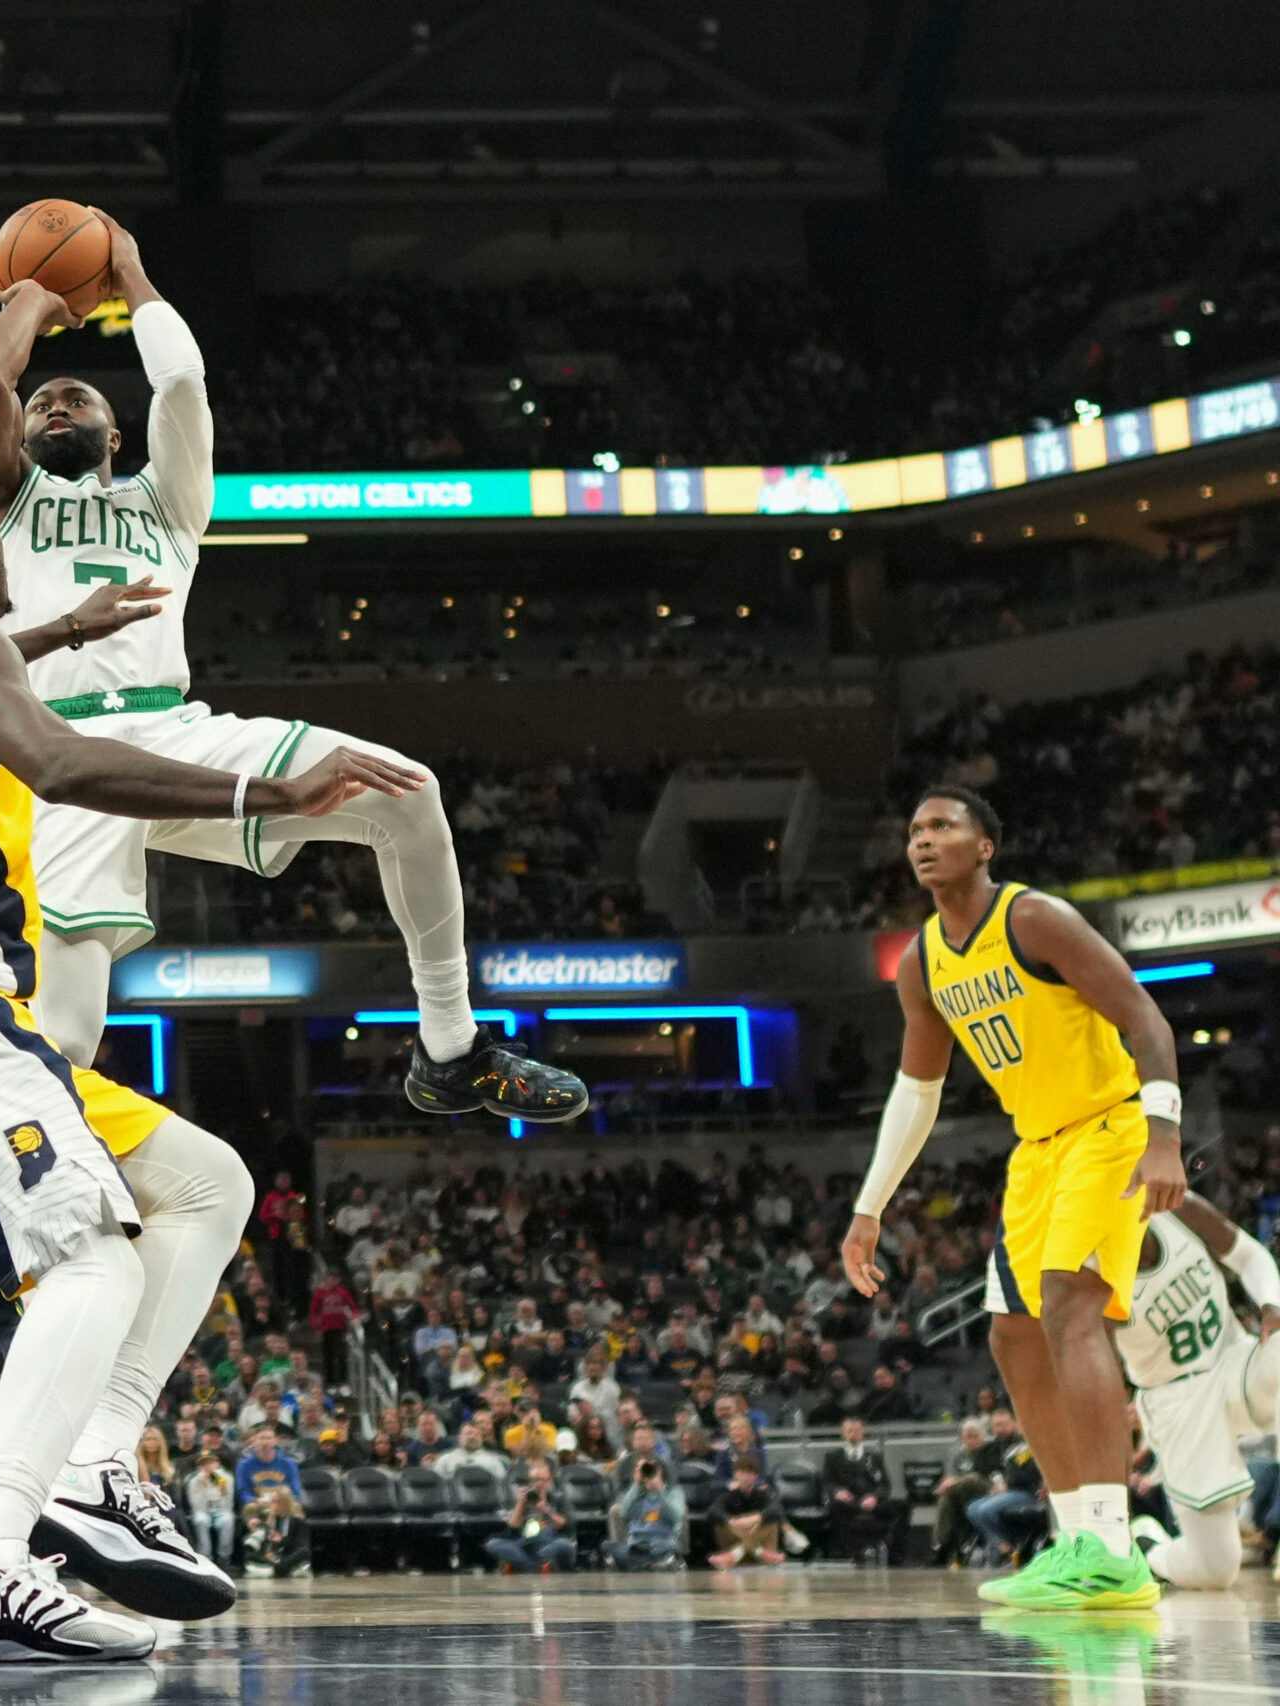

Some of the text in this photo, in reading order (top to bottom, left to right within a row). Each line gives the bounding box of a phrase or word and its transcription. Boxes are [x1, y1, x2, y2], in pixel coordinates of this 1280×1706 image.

[250, 481, 473, 510] BOSTON CELTICS
[31, 495, 163, 566] CELTICS
[1121, 899, 1252, 939] KeyBank
[480, 951, 678, 985] ticketmaster
[933, 965, 1024, 1020] INDIANA
[968, 1014, 1023, 1071] 00
[1167, 1299, 1223, 1365] 88
